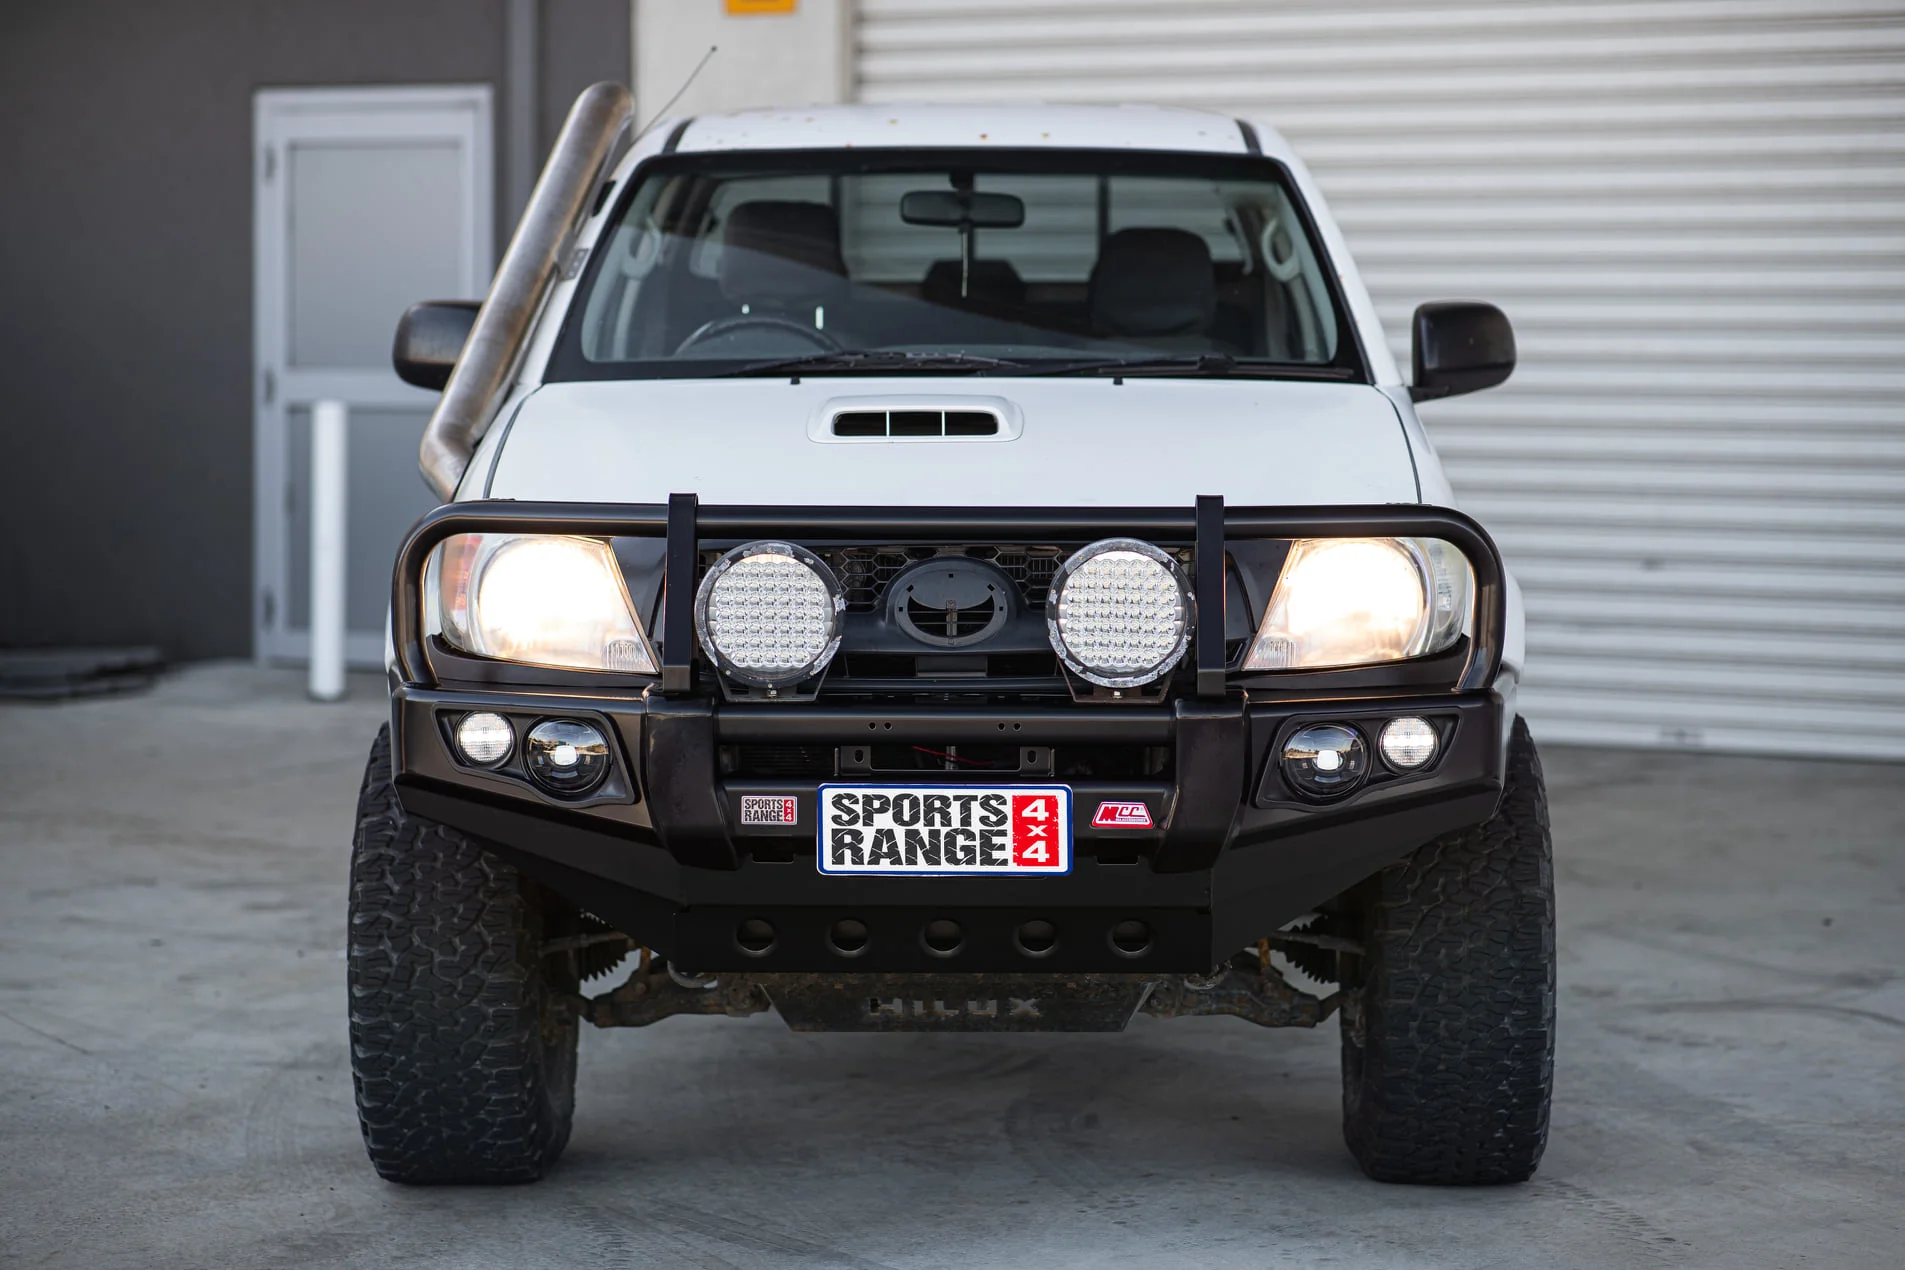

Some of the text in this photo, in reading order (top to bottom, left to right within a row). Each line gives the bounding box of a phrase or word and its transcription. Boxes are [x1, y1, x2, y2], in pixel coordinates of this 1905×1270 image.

[744, 799, 783, 810] SPORTS
[831, 793, 1009, 827] SPORTS
[744, 810, 783, 821] RANGE
[1099, 806, 1146, 821] MCC
[831, 828, 1009, 866] RANGE
[869, 997, 1041, 1017] HILUX
